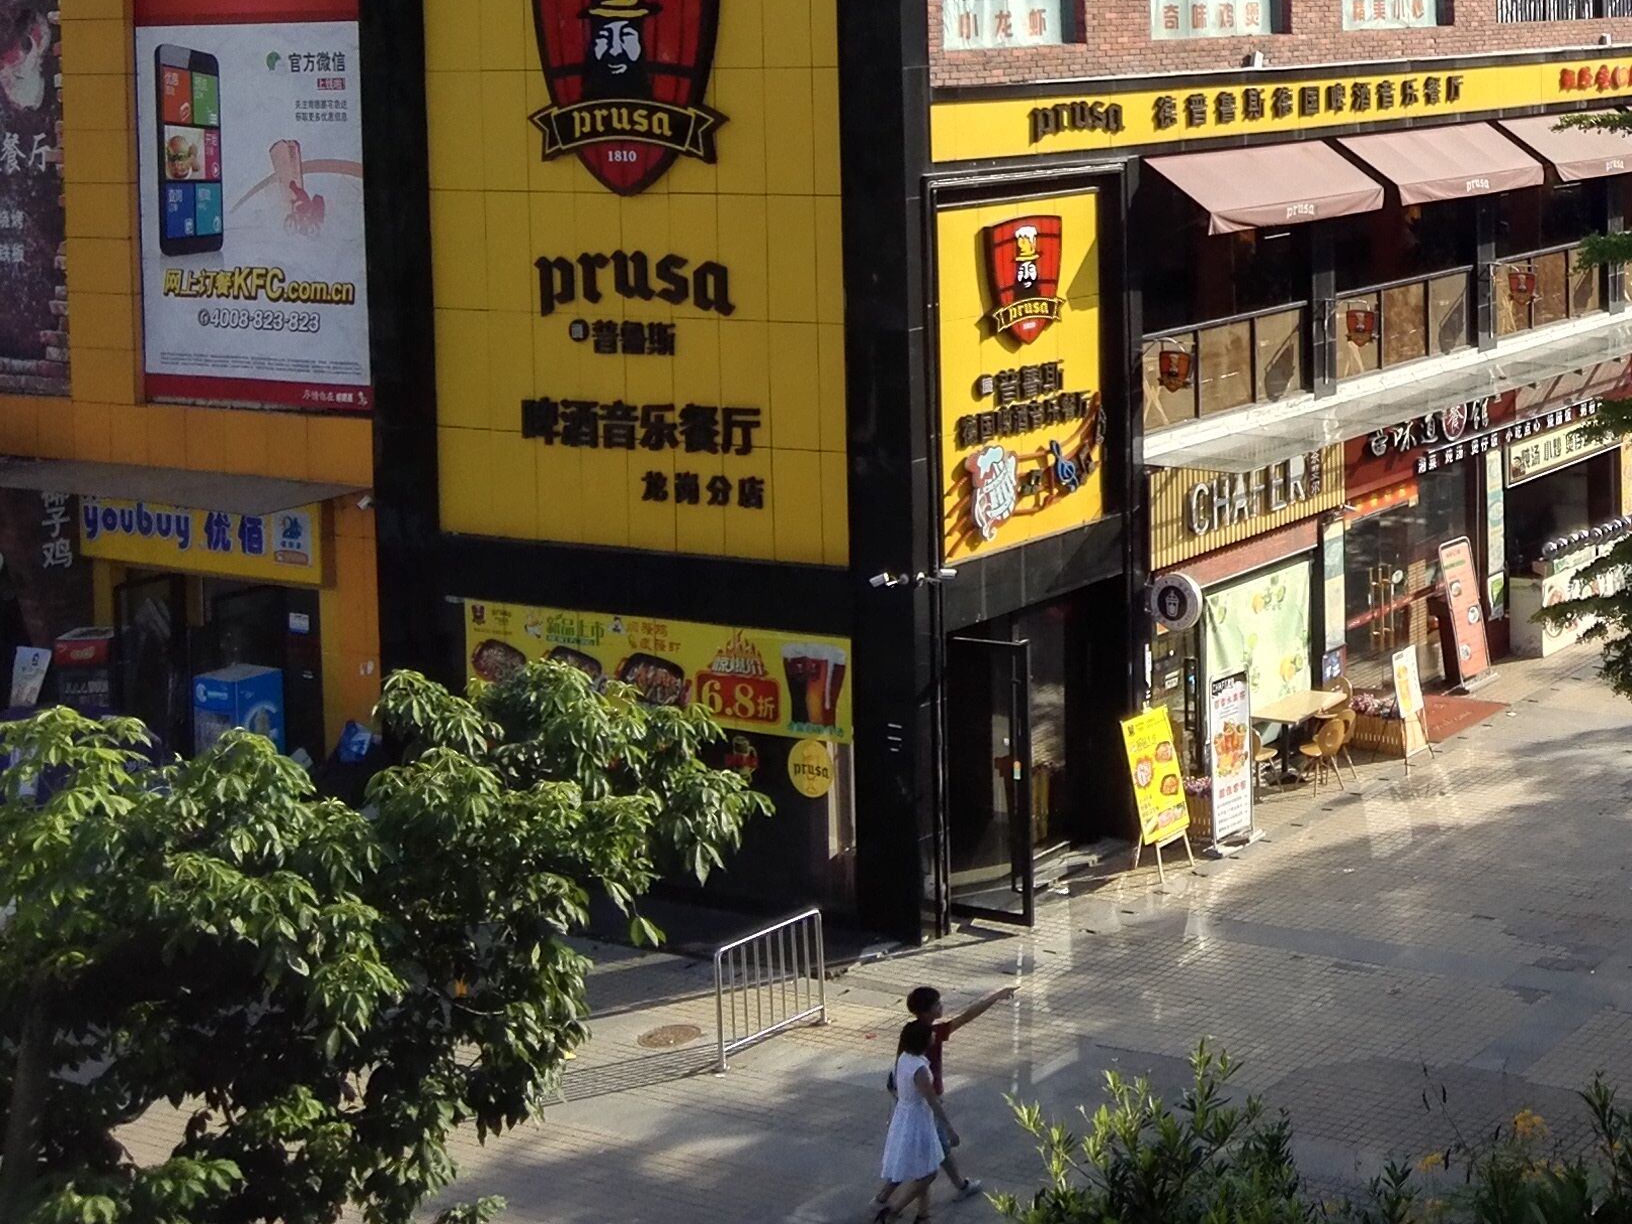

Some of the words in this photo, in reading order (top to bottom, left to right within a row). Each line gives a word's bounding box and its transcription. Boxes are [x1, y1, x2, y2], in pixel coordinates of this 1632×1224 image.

[958, 7, 1046, 40] 小龙虾
[288, 52, 346, 72] 官方微信
[573, 104, 674, 138] prusa
[1033, 101, 1125, 143] prusa
[607, 149, 637, 163] 1810
[1606, 158, 1625, 172] prusa
[1466, 177, 1490, 192] prusa
[1286, 202, 1315, 219] prusa
[534, 249, 736, 317] prusa
[208, 308, 321, 333] 4008-823-823
[1009, 300, 1049, 322] prusa
[521, 396, 762, 457] 啤酒音乐餐厅
[83, 502, 191, 549] youbuy
[204, 511, 264, 555] 优佰
[793, 760, 829, 783] prusa
